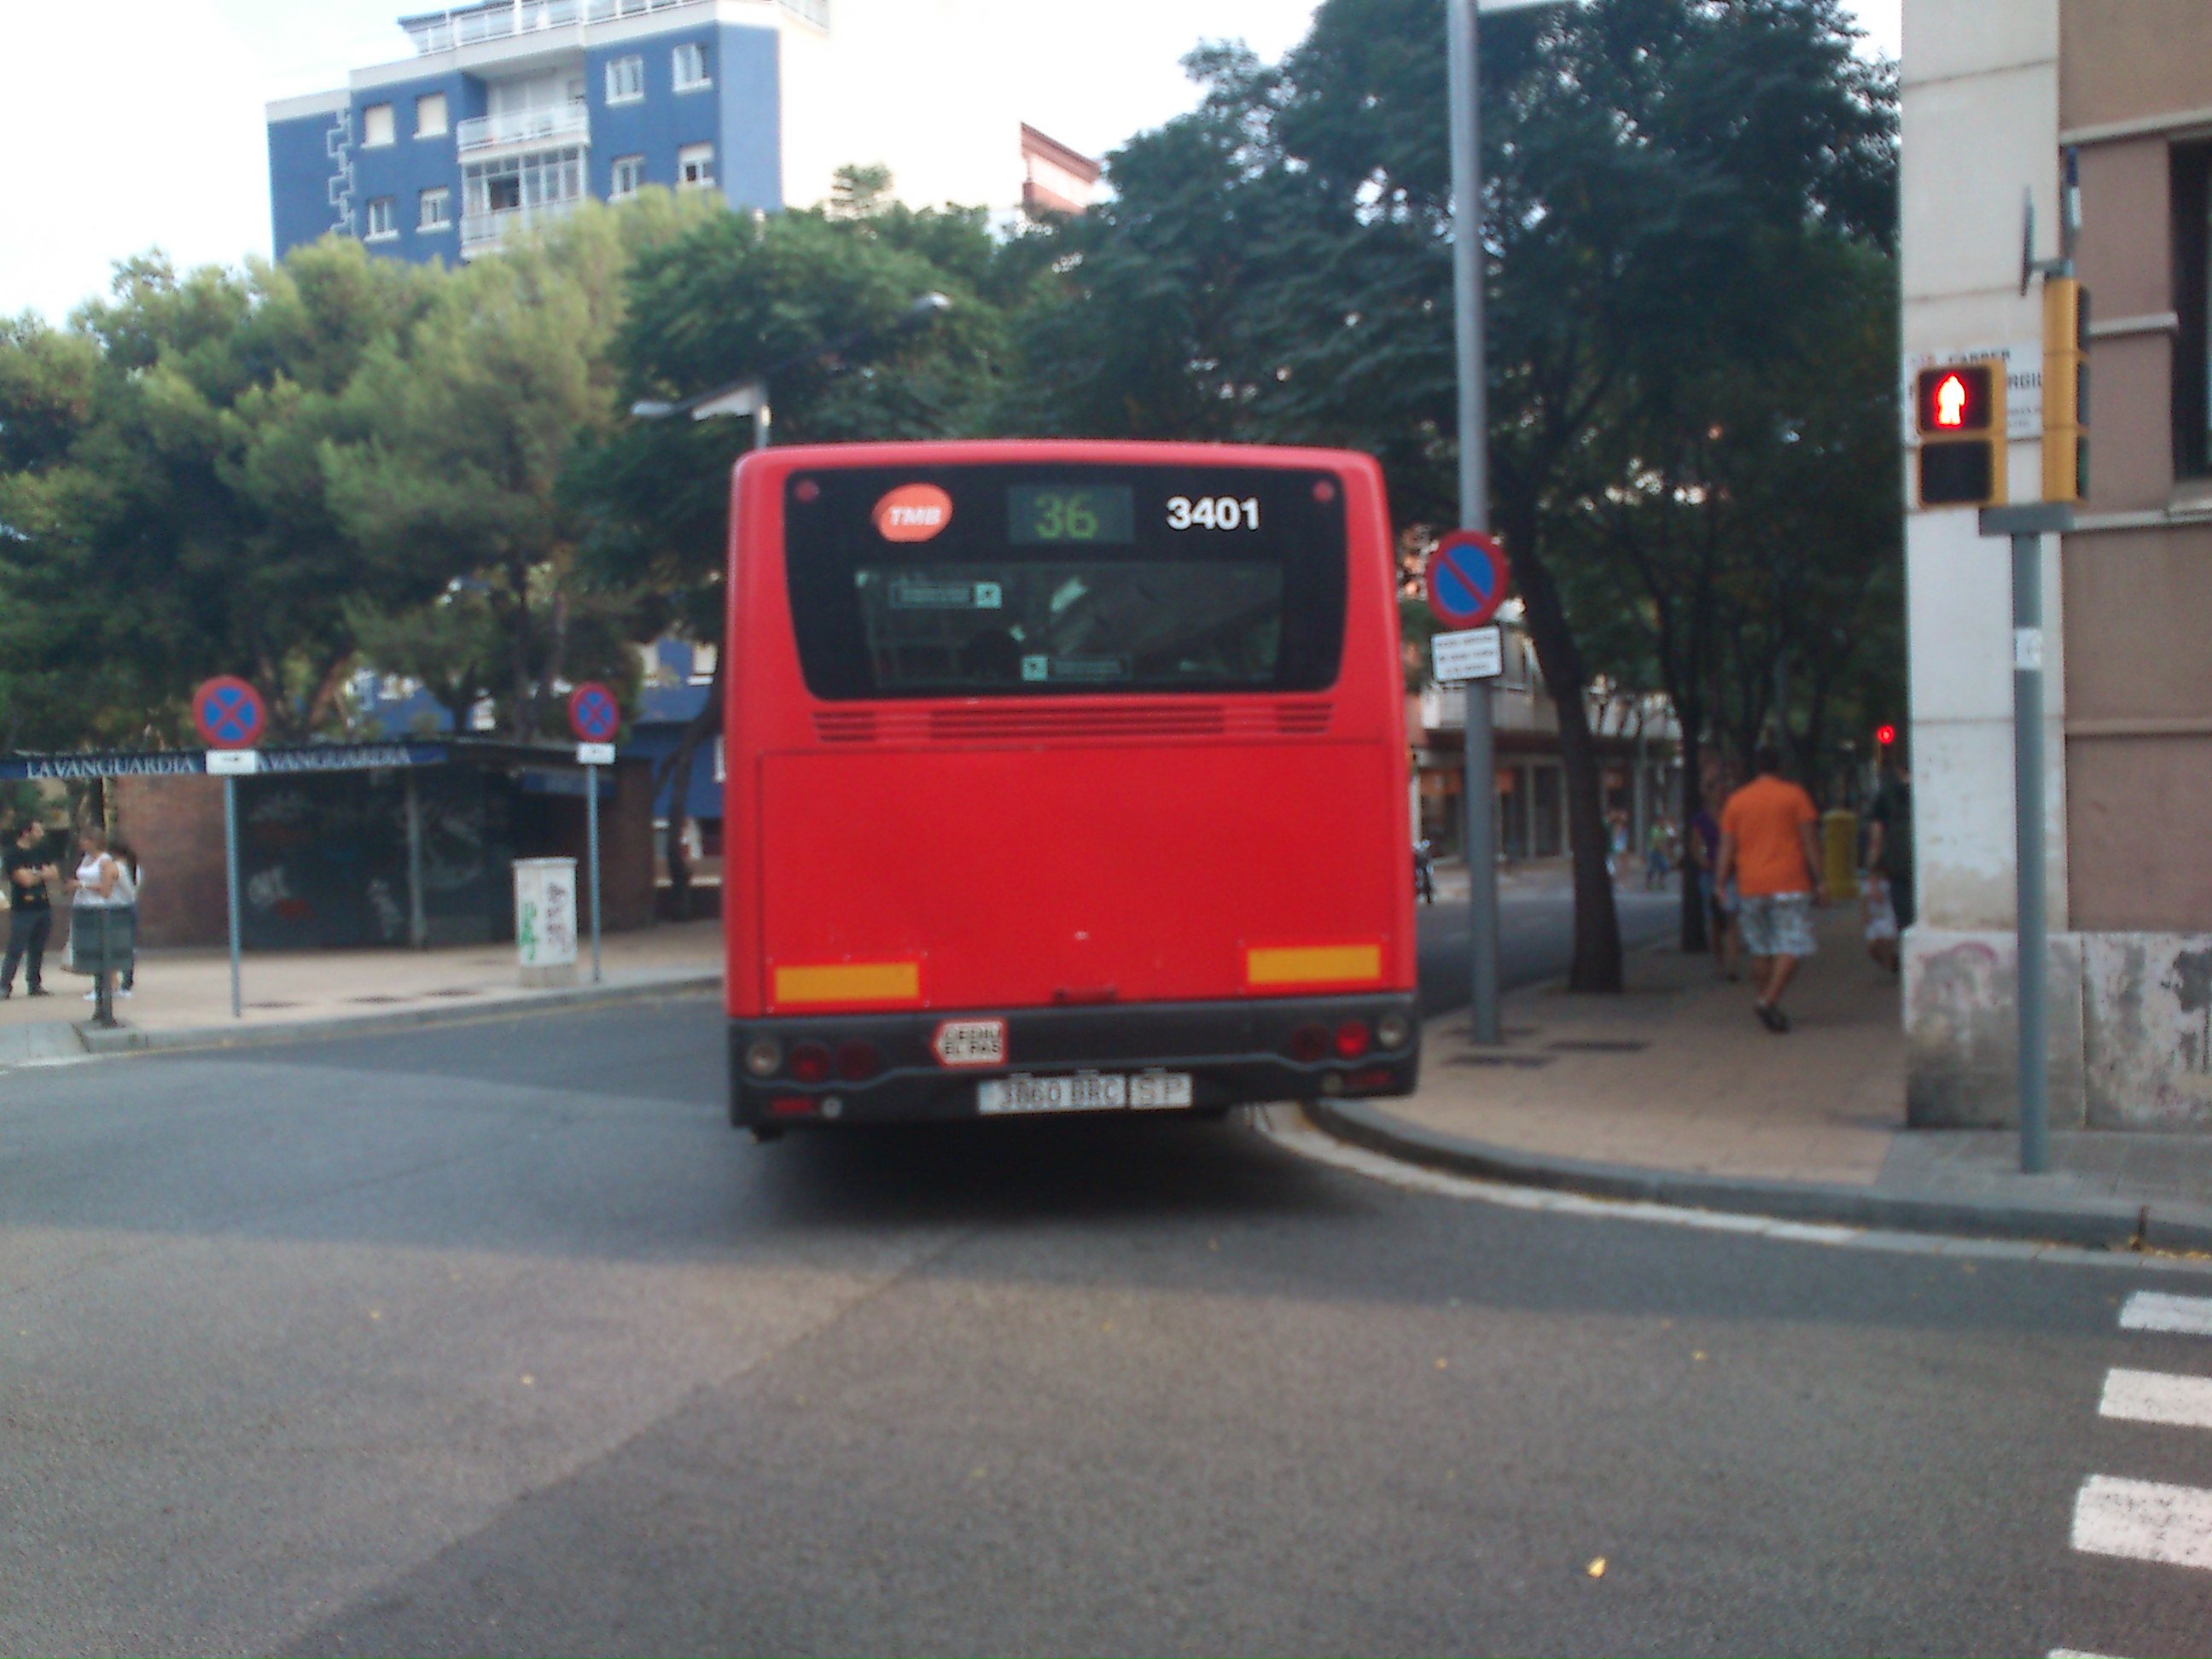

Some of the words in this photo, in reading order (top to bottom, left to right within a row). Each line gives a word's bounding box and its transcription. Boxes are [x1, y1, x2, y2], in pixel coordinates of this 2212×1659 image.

[888, 505, 942, 527] TMB
[1035, 492, 1098, 539] 36
[1165, 496, 1260, 531] 3401
[26, 760, 51, 779] LA
[53, 756, 195, 777] VANGUARDIA
[1139, 1076, 1185, 1107] SP
